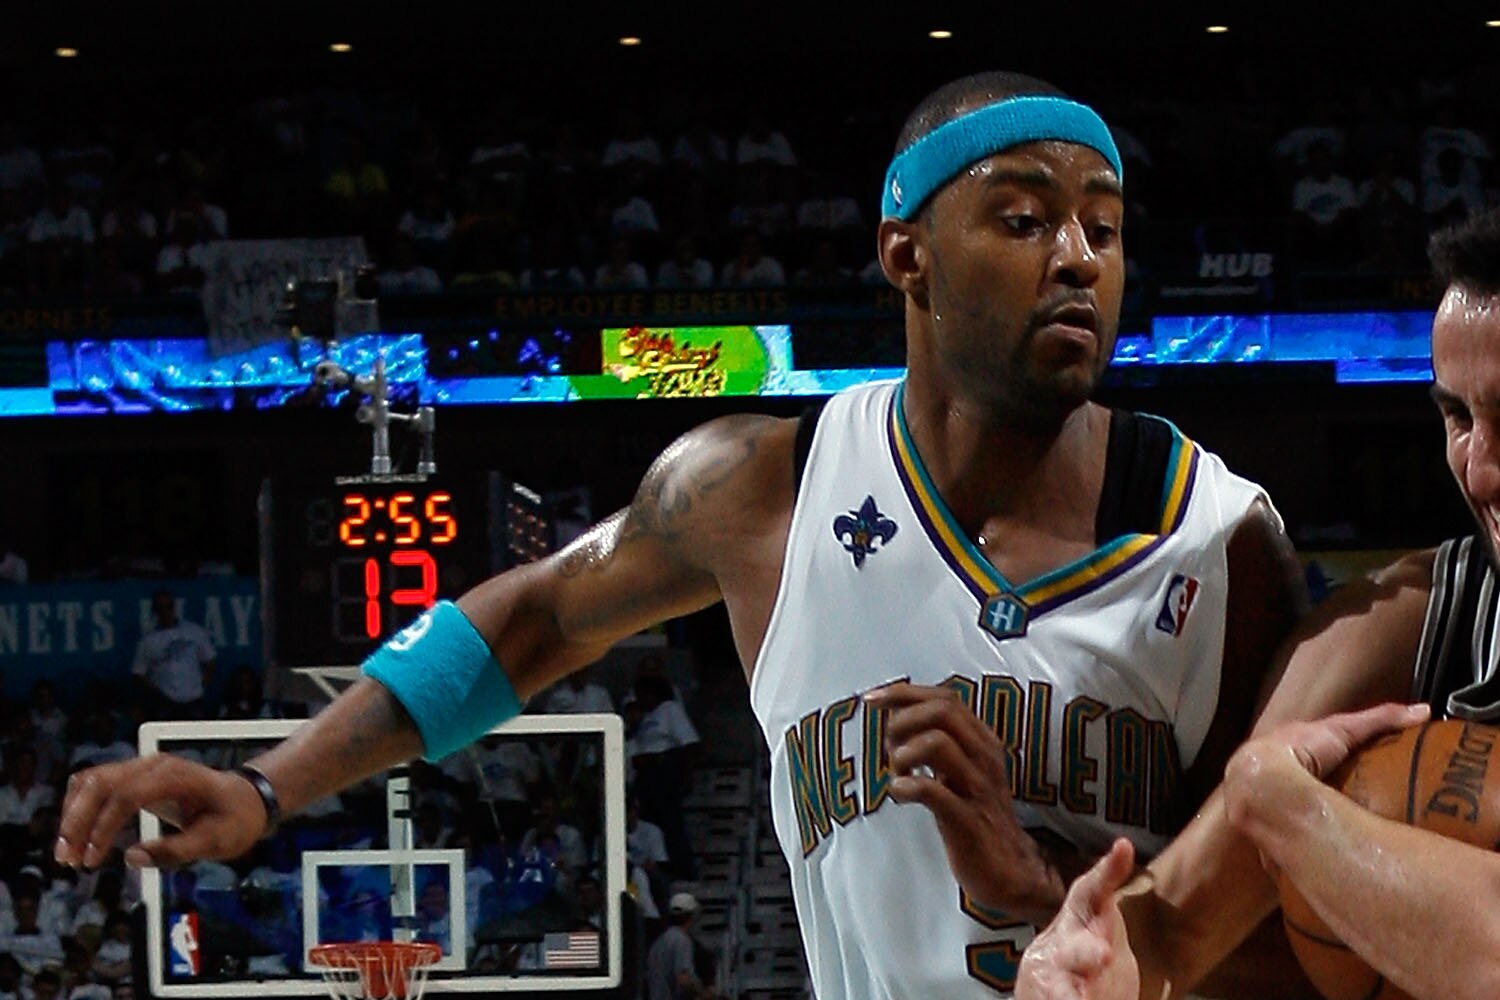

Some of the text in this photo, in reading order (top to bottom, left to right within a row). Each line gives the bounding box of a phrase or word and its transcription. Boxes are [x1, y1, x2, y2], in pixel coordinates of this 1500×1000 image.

[1198, 252, 1275, 278] HUB
[495, 291, 787, 318] EMPLOYEE BENEFITS
[340, 493, 457, 546] 2:55
[937, 671, 1182, 838] RLEAN
